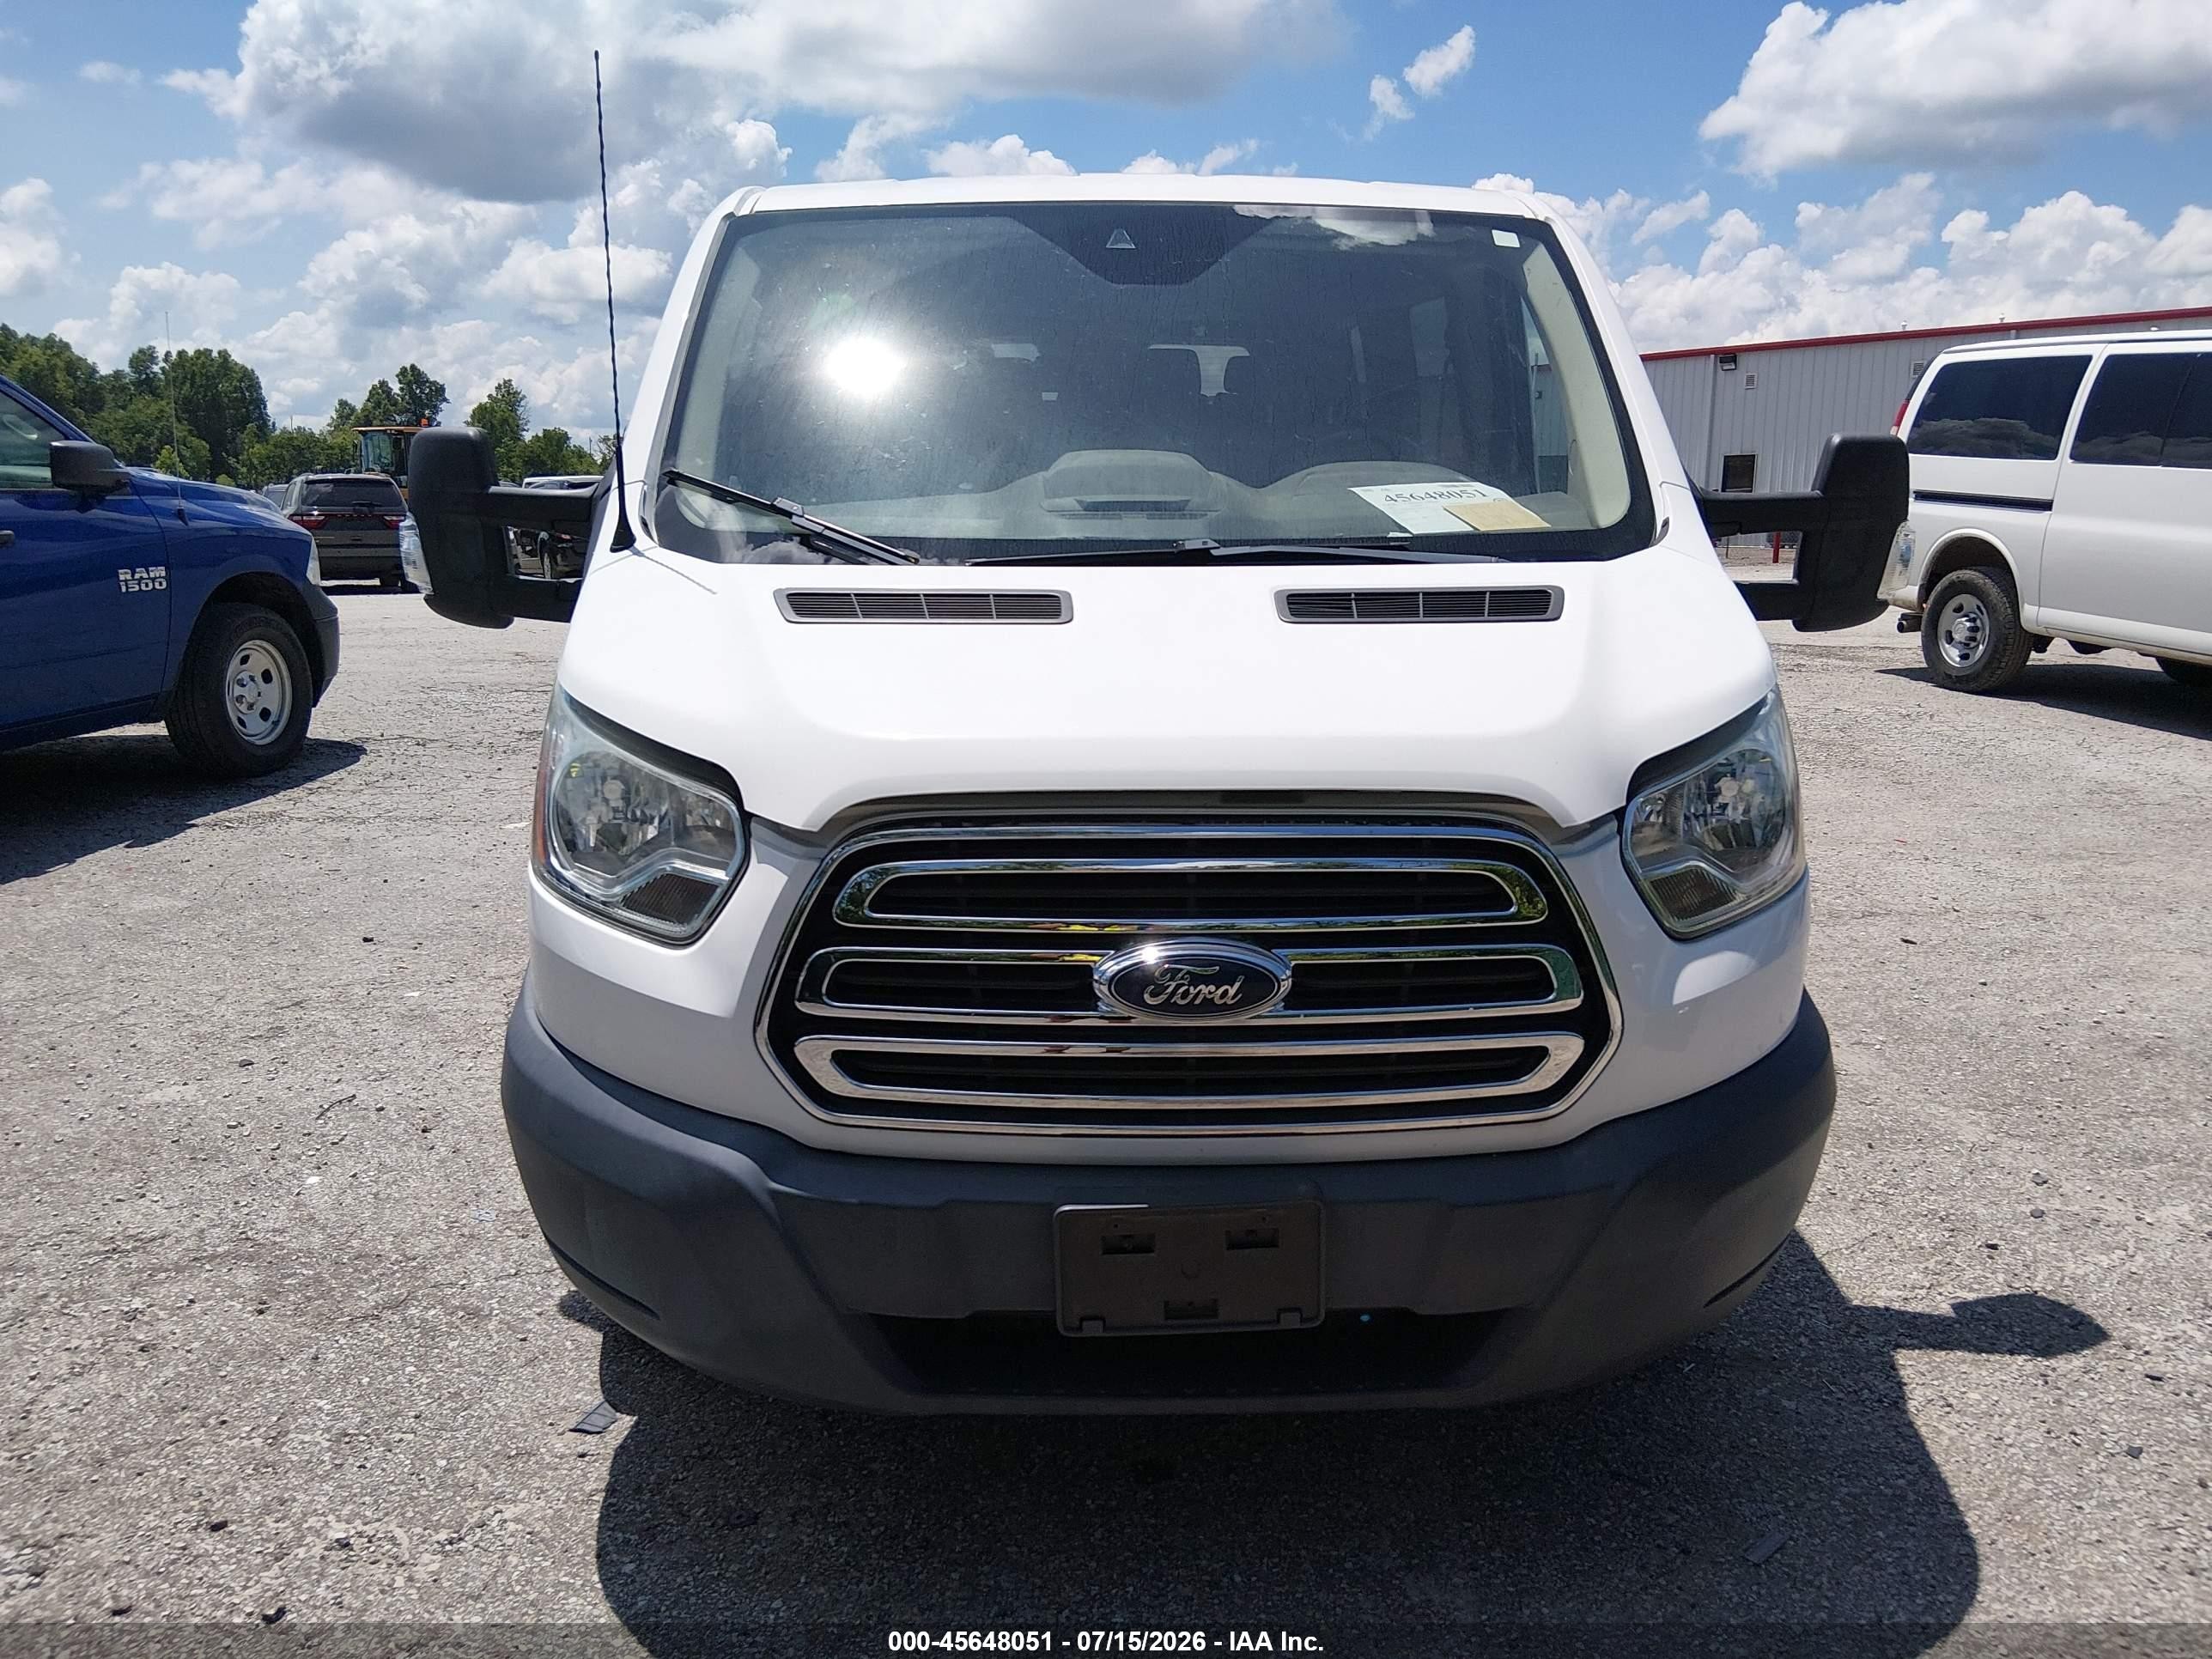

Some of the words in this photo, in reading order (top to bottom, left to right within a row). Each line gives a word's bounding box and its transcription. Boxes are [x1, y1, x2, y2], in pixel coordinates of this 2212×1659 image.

[1384, 489, 1488, 503] 45648051
[118, 567, 167, 580] RAM
[119, 578, 167, 592] 1500
[1143, 963, 1245, 1006] Ford
